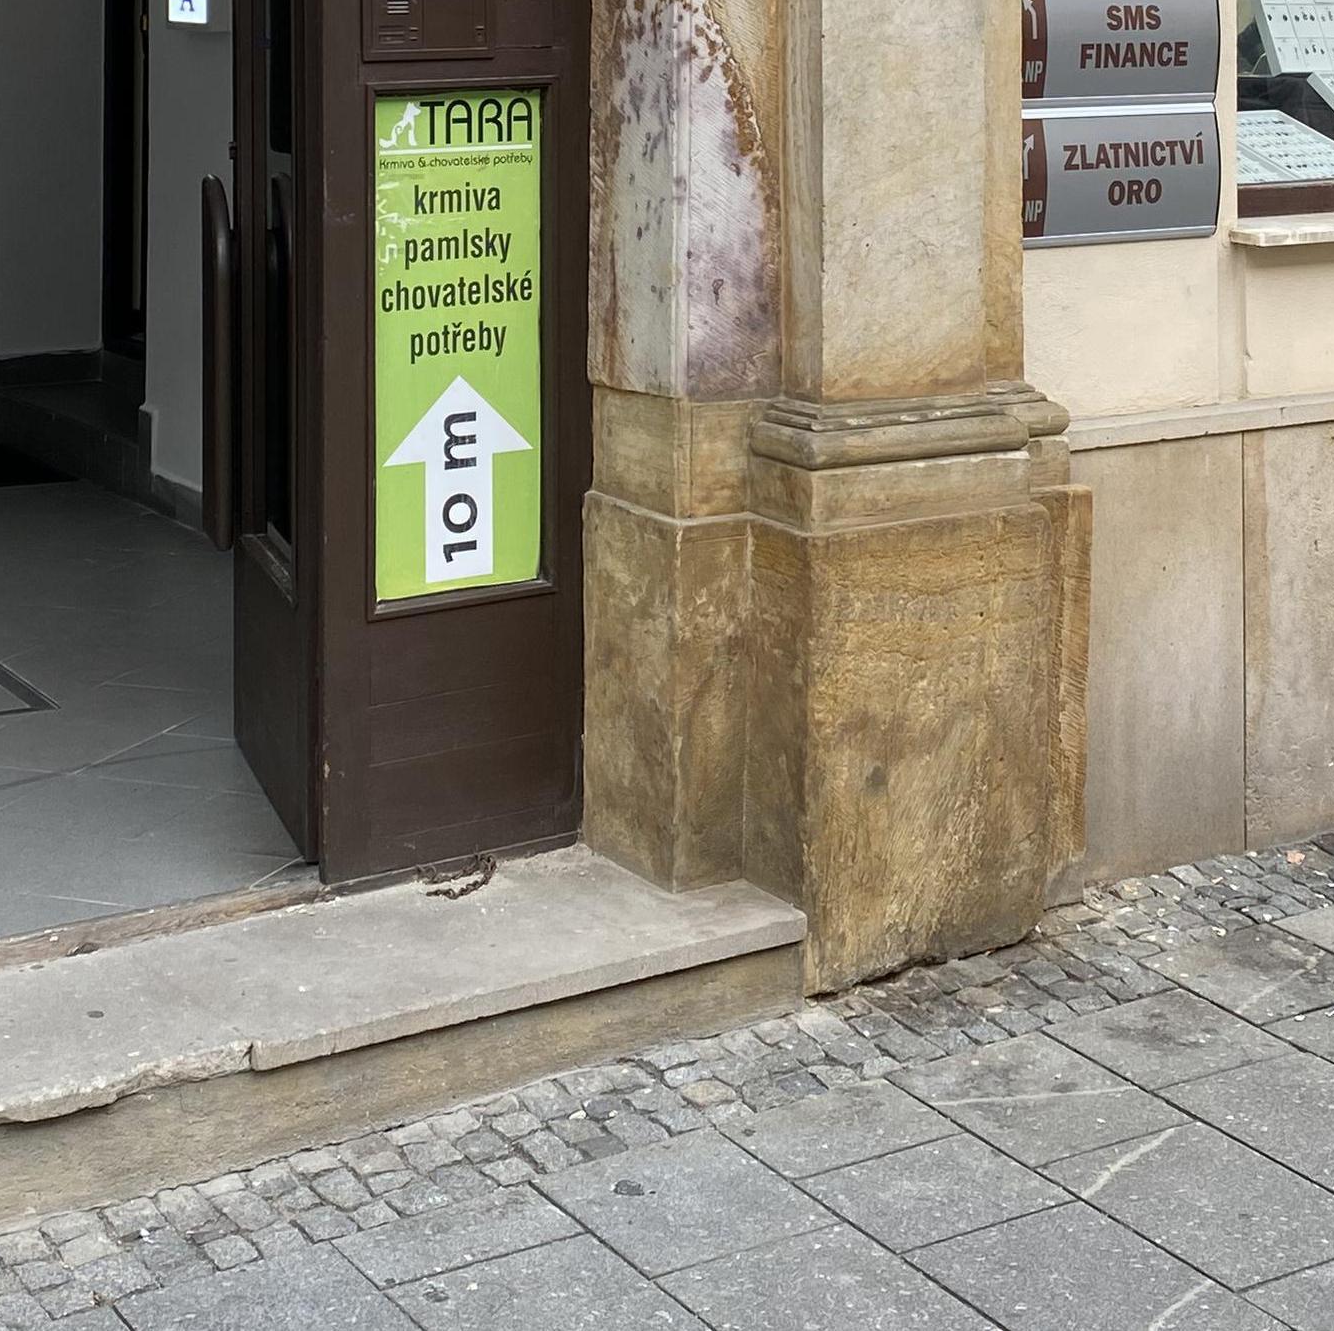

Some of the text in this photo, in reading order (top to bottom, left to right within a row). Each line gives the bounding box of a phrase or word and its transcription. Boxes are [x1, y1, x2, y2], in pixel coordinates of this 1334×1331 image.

[1106, 4, 1162, 31] SMS
[1079, 41, 1189, 69] FINANCE
[420, 97, 533, 145] TARA
[379, 158, 415, 170] Krmiva
[429, 155, 490, 167] chovatelské
[493, 152, 532, 166] potřeby
[1063, 131, 1204, 171] ZLATNICTVÍ
[414, 183, 501, 215] krmiva
[1107, 178, 1163, 207] ORO
[404, 228, 511, 270] pamlsky
[381, 270, 533, 313] chovatelské
[410, 322, 507, 365] potřeby
[442, 411, 478, 564] 10 m
